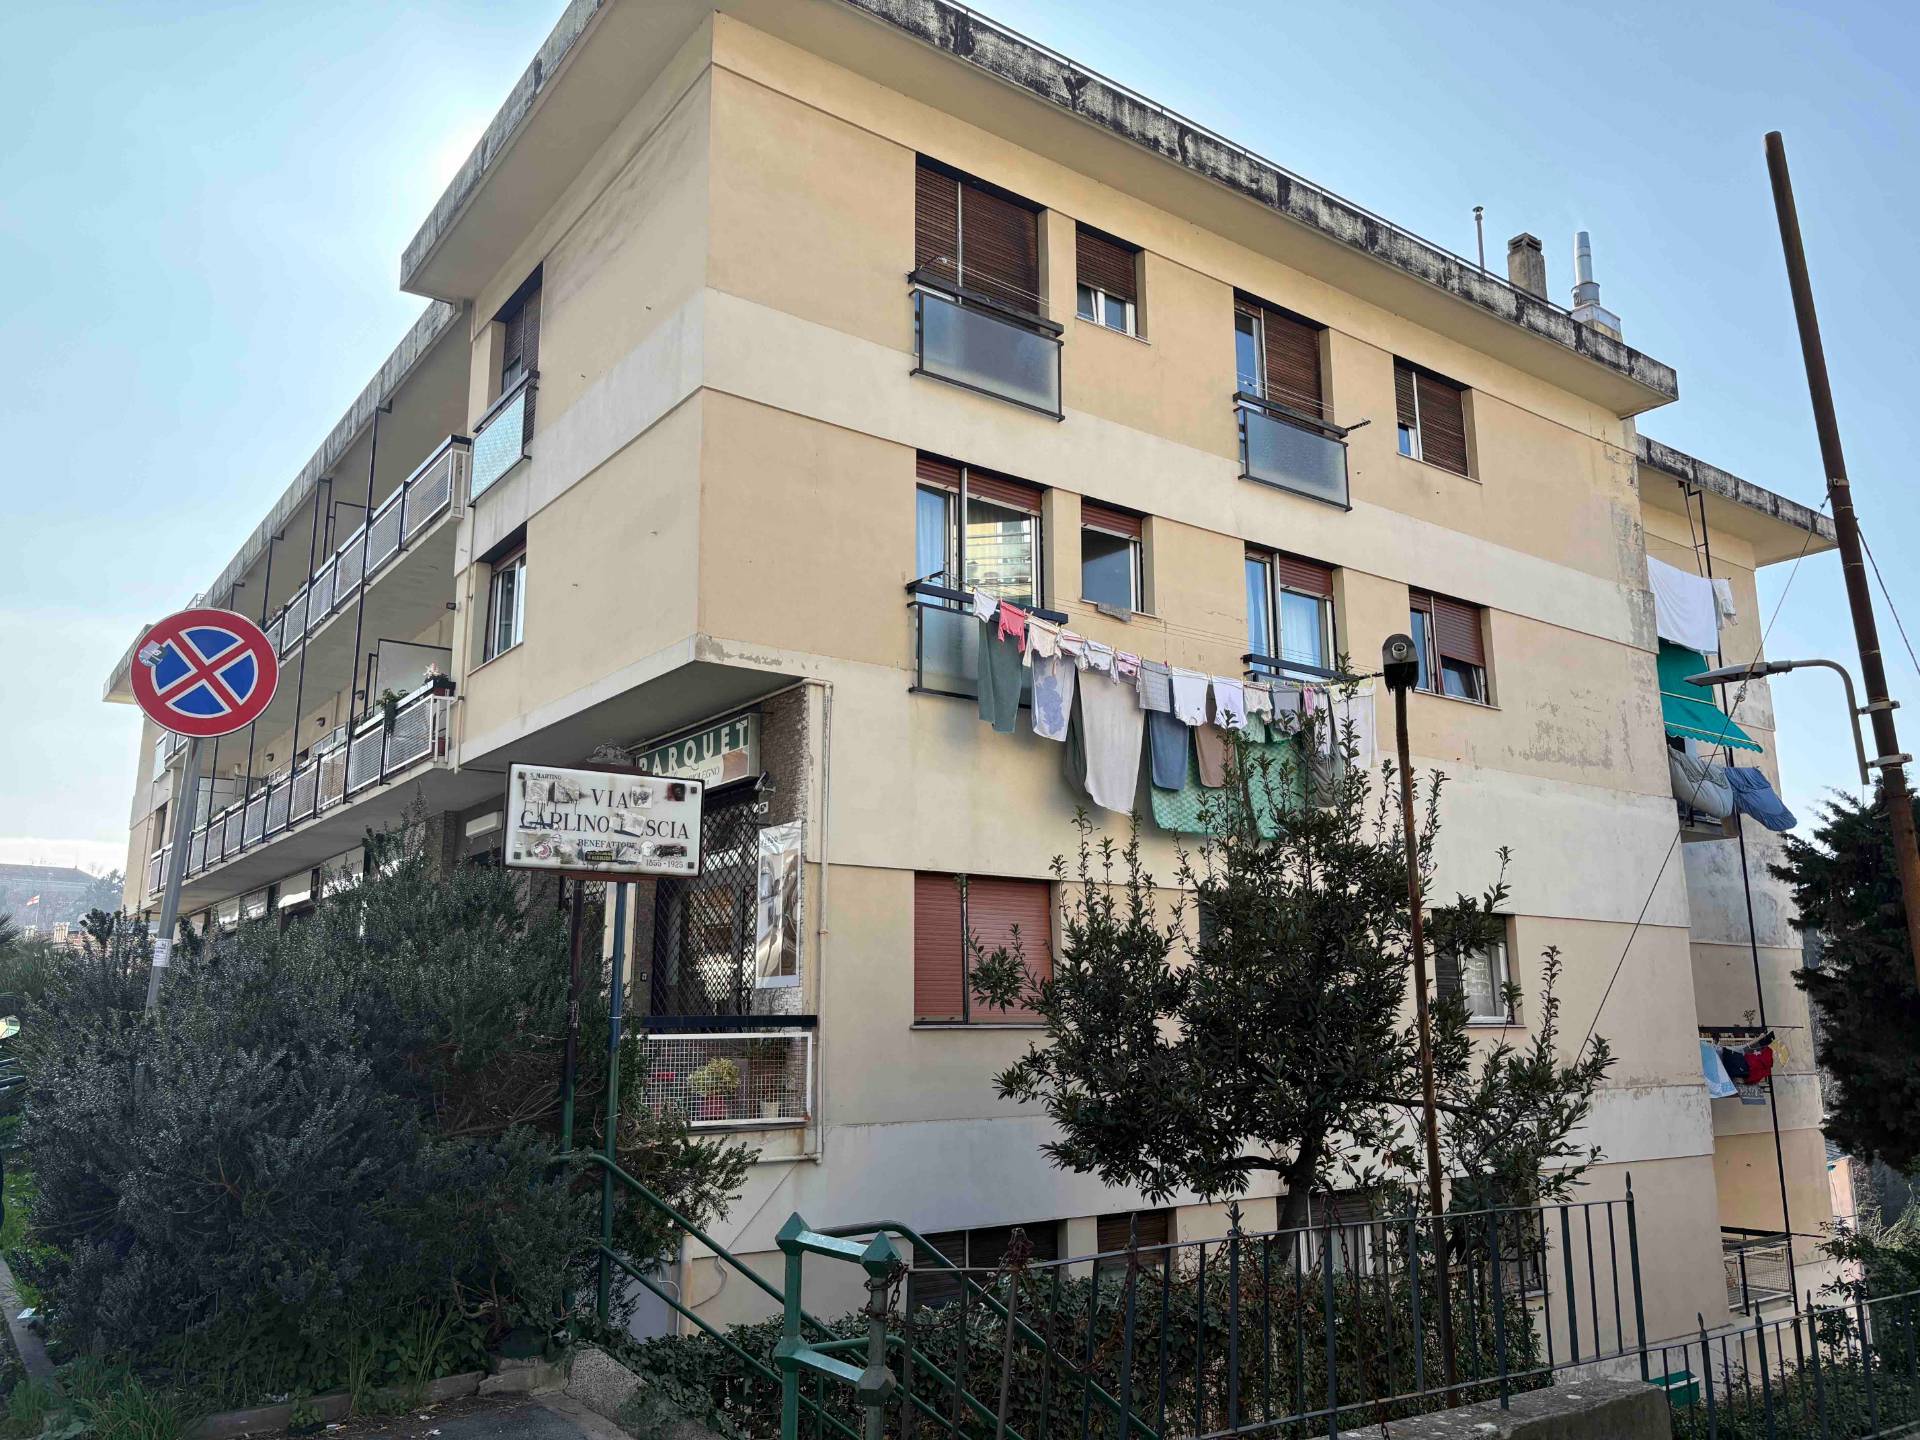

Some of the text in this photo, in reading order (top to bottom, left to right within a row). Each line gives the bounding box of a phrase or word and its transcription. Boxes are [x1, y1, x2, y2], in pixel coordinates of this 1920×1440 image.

[639, 719, 748, 776] PARQUET
[591, 788, 629, 809] VIA
[521, 810, 610, 833] CARLINO
